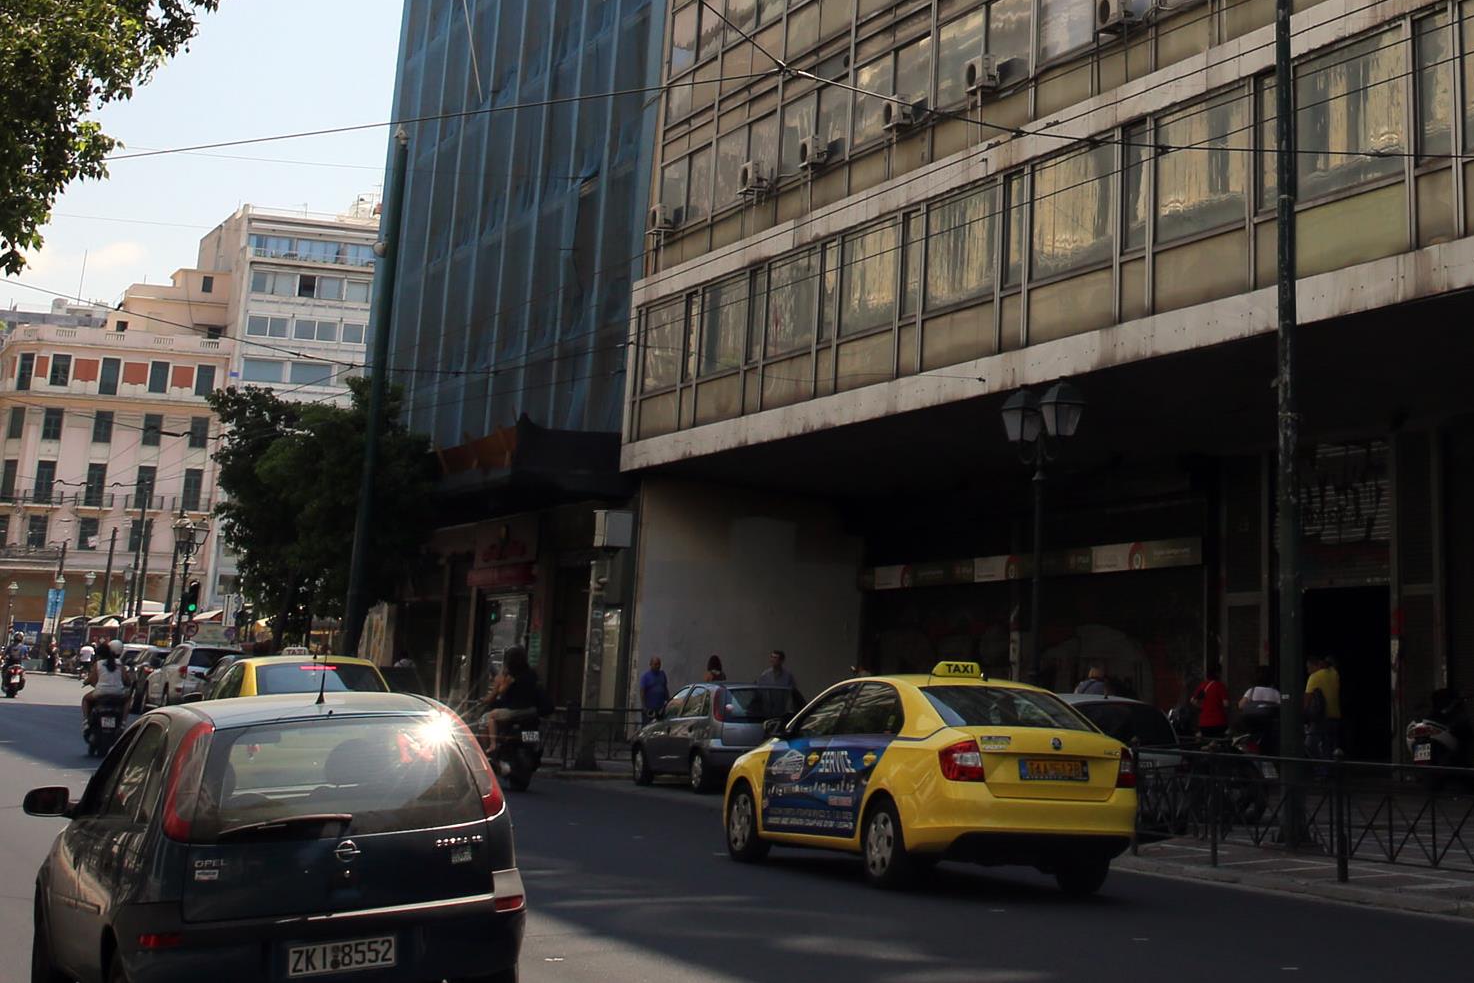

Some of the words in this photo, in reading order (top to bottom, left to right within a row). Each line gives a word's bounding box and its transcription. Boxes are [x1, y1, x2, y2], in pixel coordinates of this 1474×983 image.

[946, 664, 974, 674] TAXI
[818, 751, 856, 773] SERVICE
[194, 859, 227, 868] OPEL
[341, 939, 393, 967] 8552
